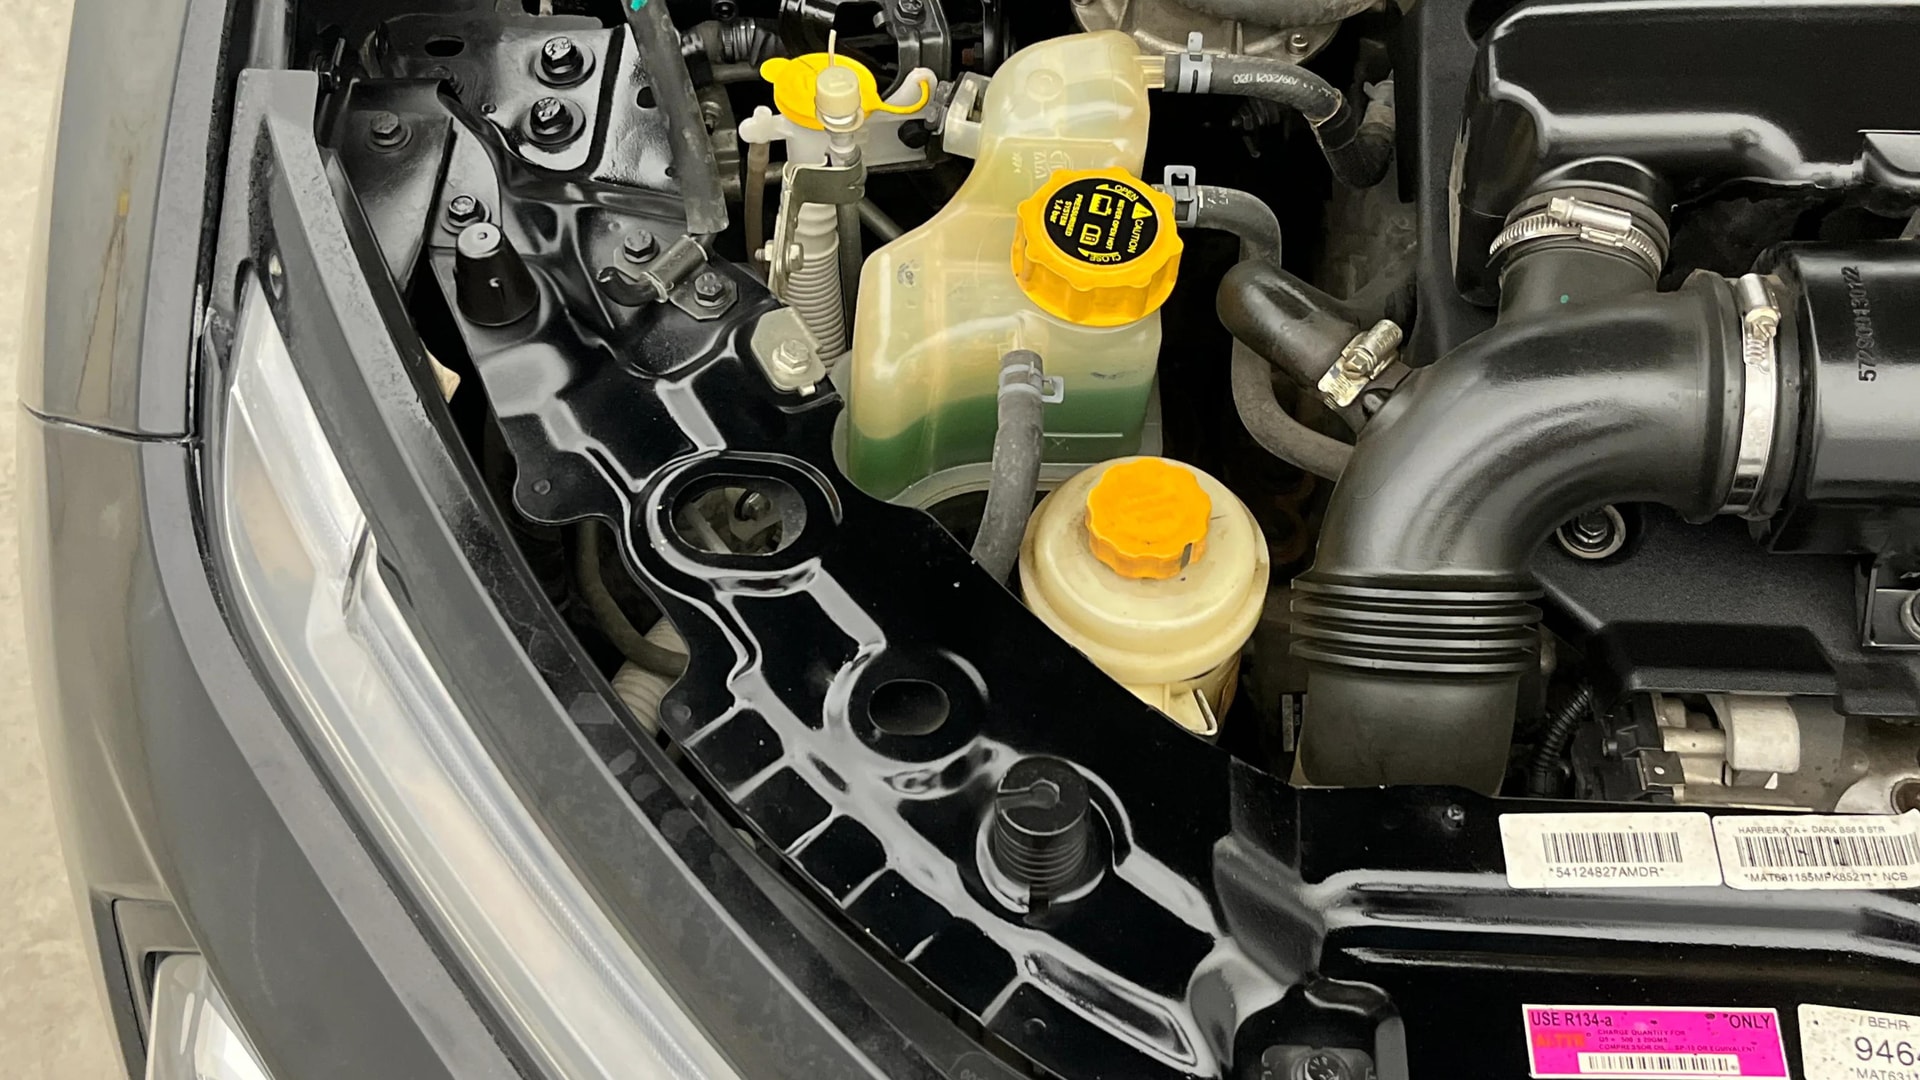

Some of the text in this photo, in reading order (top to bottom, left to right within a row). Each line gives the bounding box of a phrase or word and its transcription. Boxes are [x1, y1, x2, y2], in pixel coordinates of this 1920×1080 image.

[1114, 184, 1139, 202] OPEN
[1050, 210, 1061, 224] bar
[1059, 200, 1072, 226] SYSTEM
[1105, 199, 1125, 250] NEVER OPEN HOT
[1127, 219, 1144, 253] CAUTION
[1089, 252, 1121, 262] CLOSE
[1811, 825, 1837, 834] DARK
[1882, 872, 1909, 882] NCB
[1531, 1011, 1771, 1029] USE R134-a ONLY
[1868, 1016, 1911, 1031] BEHR
[1854, 1036, 1920, 1066] 946
